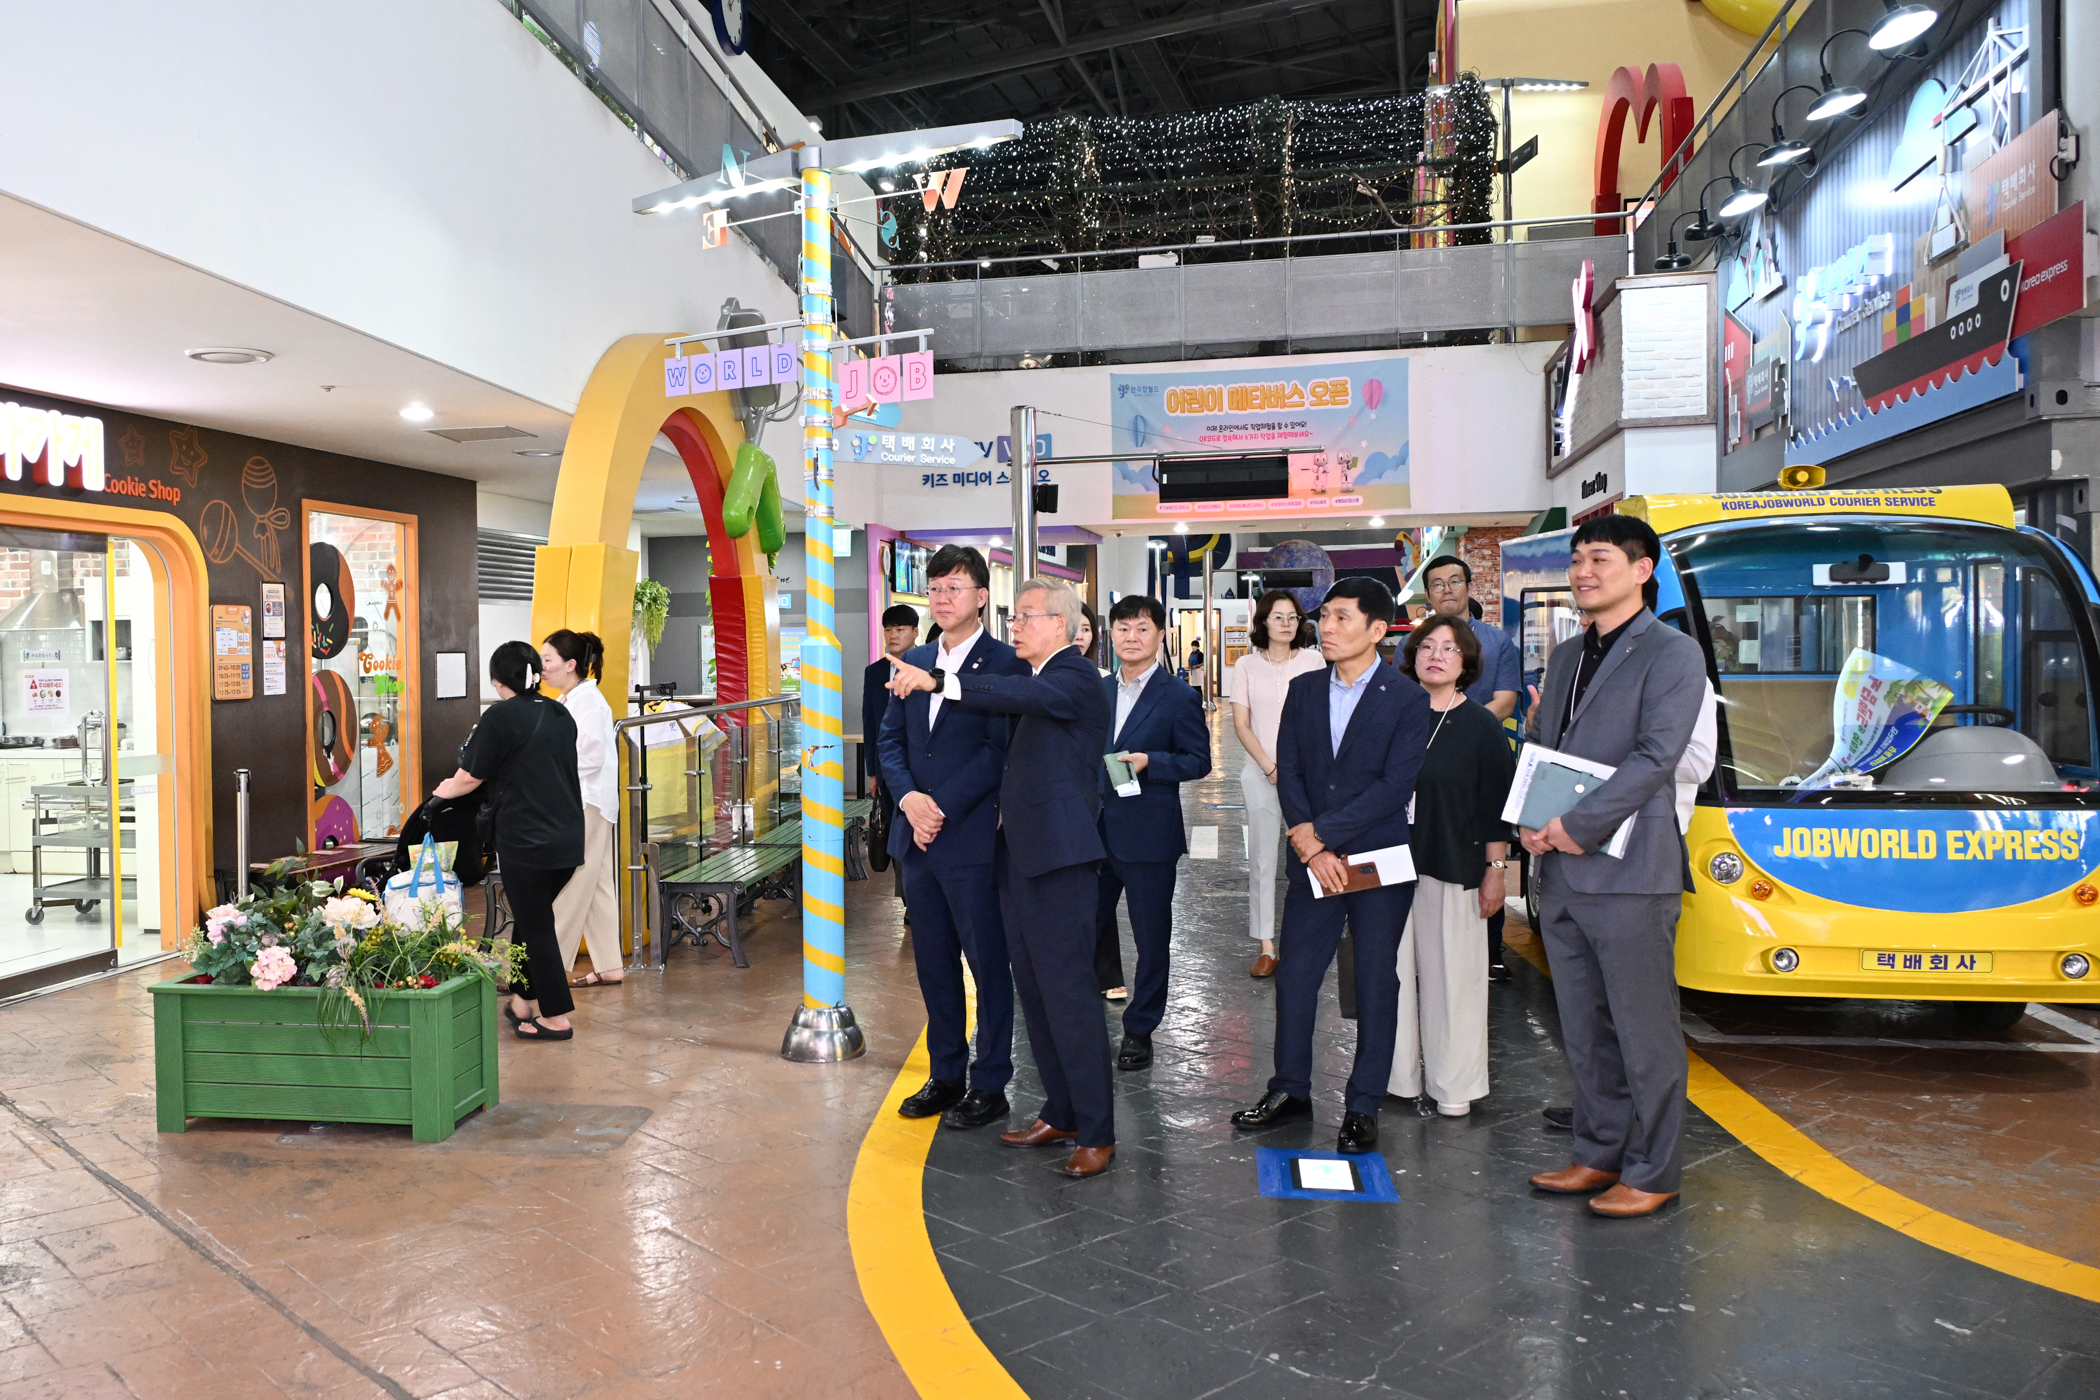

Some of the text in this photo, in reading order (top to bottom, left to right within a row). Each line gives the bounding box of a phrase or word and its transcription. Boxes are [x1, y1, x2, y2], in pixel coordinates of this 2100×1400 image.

[912, 167, 970, 212] W
[1862, 291, 1891, 319] Service
[667, 353, 793, 388] WORLD
[846, 362, 927, 399] JOB
[1130, 385, 1159, 394] 한국잡월드
[1165, 379, 1350, 414] 어린이 메타버스 오픈
[1250, 421, 1276, 431] 직업체험을
[1260, 431, 1276, 440] 직업을
[881, 434, 956, 453] 택배회사
[881, 452, 956, 466] Courier Service
[104, 473, 181, 506] Cookie Shop
[922, 469, 1051, 488] 키즈 미디어 스오
[1721, 496, 1937, 511] KOREAJOBWORLD COURIER SERVICE
[359, 651, 402, 674] Cookie
[373, 674, 404, 697] Shop
[1773, 827, 2080, 860] JOBWORLD EXPRESS
[1876, 953, 1977, 972] 택배회사
